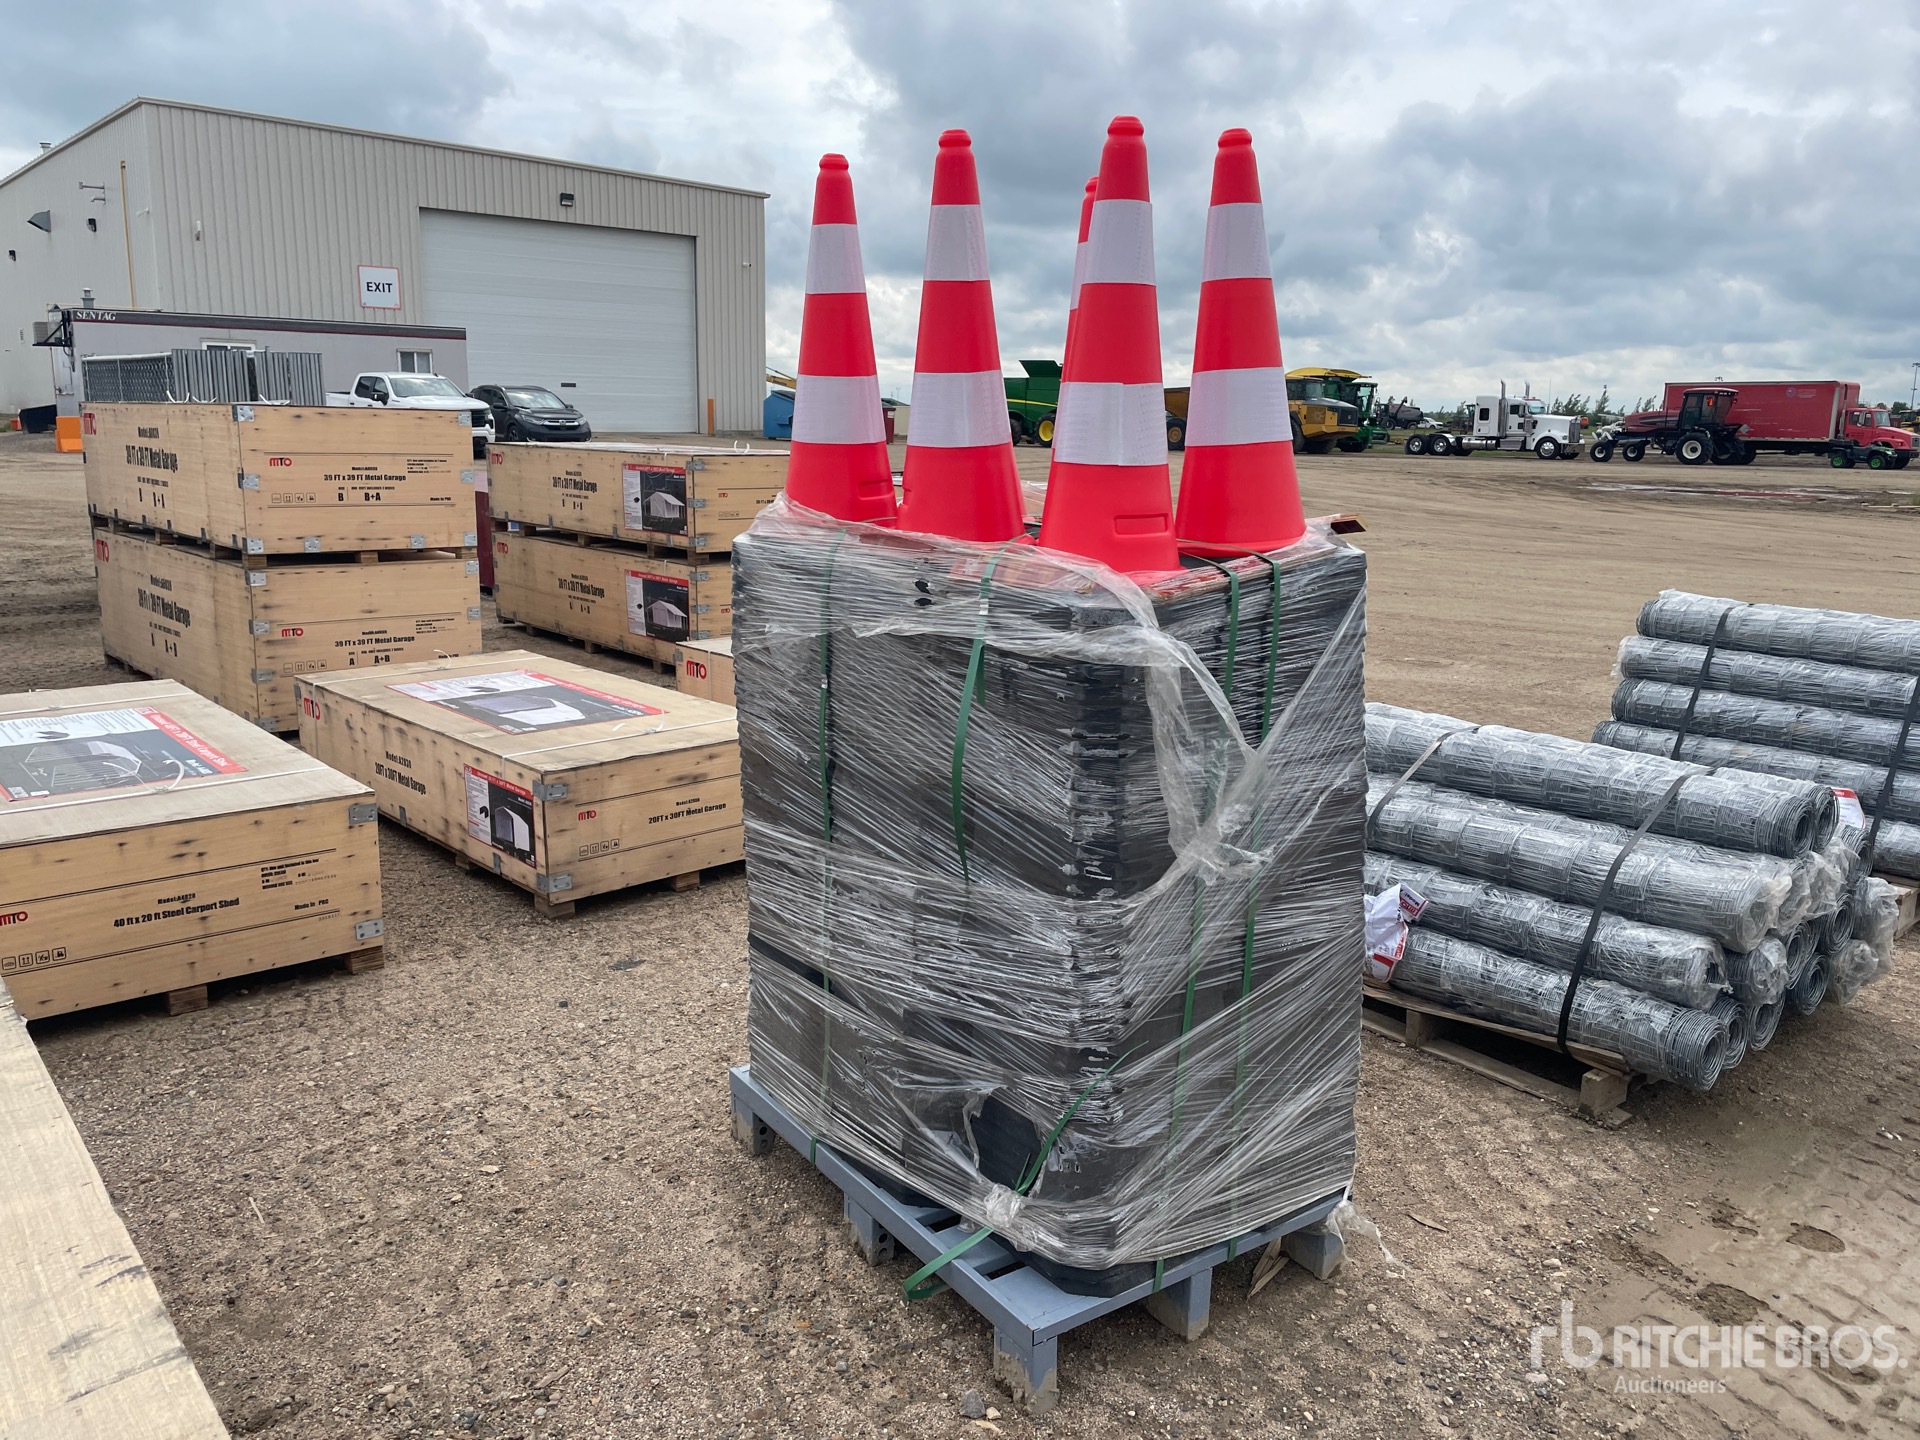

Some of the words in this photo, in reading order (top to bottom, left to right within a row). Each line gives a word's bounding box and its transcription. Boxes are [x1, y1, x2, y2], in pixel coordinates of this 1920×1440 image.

[366, 281, 393, 293] EXIT
[76, 311, 117, 321] SENTAG
[270, 457, 293, 467] MTO
[338, 492, 344, 501] B
[364, 492, 382, 501] B+A
[281, 627, 304, 638] MTO
[335, 640, 344, 648] 39
[374, 636, 392, 644] Metal
[349, 658, 355, 666] A
[374, 654, 391, 664] A+B
[686, 660, 707, 680] MTO
[303, 697, 321, 721] MTO
[397, 771, 410, 788] Metal
[410, 776, 426, 796] Garage
[578, 810, 597, 821] MTO
[648, 815, 664, 824] 20FT
[669, 810, 685, 820] 30FT
[685, 806, 704, 816] Metal
[704, 803, 727, 813] Garage
[113, 919, 125, 928] 40
[126, 917, 134, 925] ft
[134, 916, 141, 924] x
[141, 913, 153, 923] 20
[153, 912, 162, 921] ft
[162, 908, 185, 919] Steel
[185, 902, 218, 915] Carport
[218, 897, 240, 909] Shed
[294, 903, 310, 911] Made
[0, 911, 29, 927] MTO
